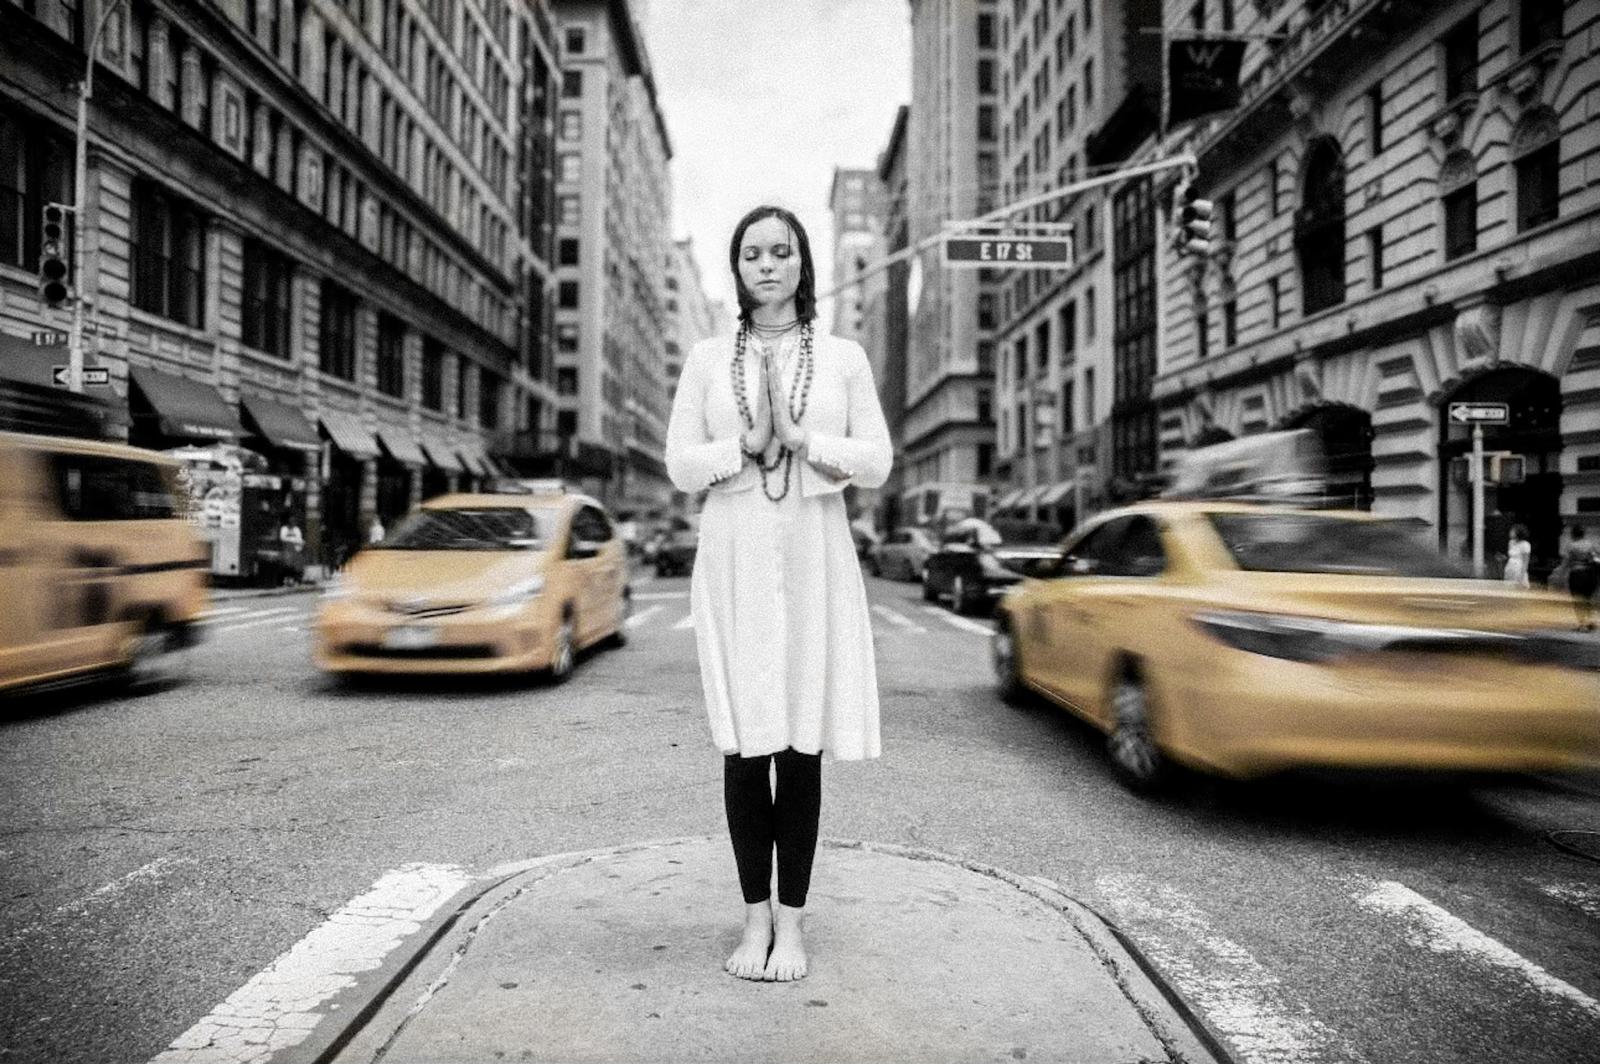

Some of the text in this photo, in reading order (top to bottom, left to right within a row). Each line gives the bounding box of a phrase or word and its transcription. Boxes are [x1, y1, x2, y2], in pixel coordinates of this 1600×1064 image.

[1186, 44, 1224, 69] W
[981, 242, 991, 260] E
[996, 242, 1011, 260] 17
